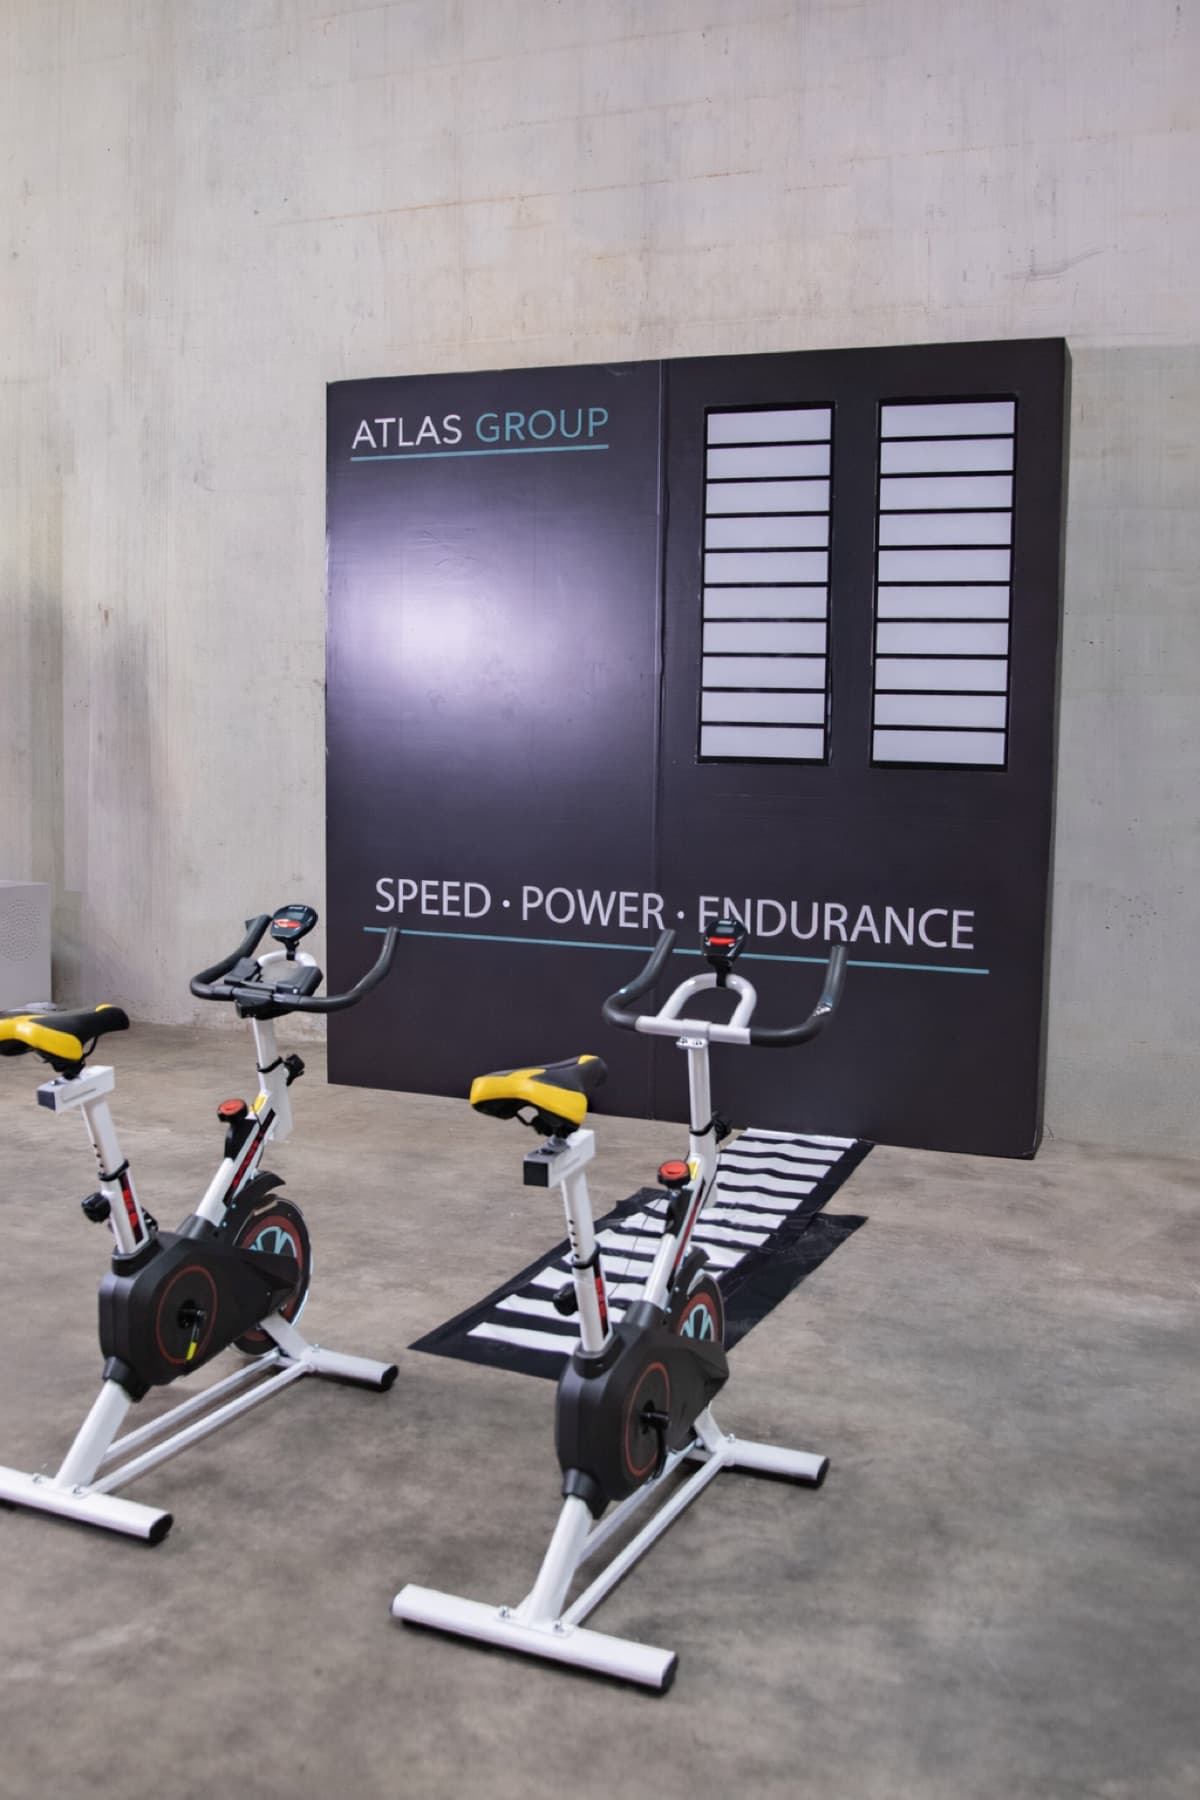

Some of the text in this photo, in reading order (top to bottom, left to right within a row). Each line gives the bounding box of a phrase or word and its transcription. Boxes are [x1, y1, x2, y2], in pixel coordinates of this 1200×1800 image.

[351, 407, 609, 450] ATLAS GROUP
[375, 877, 491, 919] SPEED
[521, 886, 665, 930] POWER
[699, 895, 975, 950] ENDURANCE
